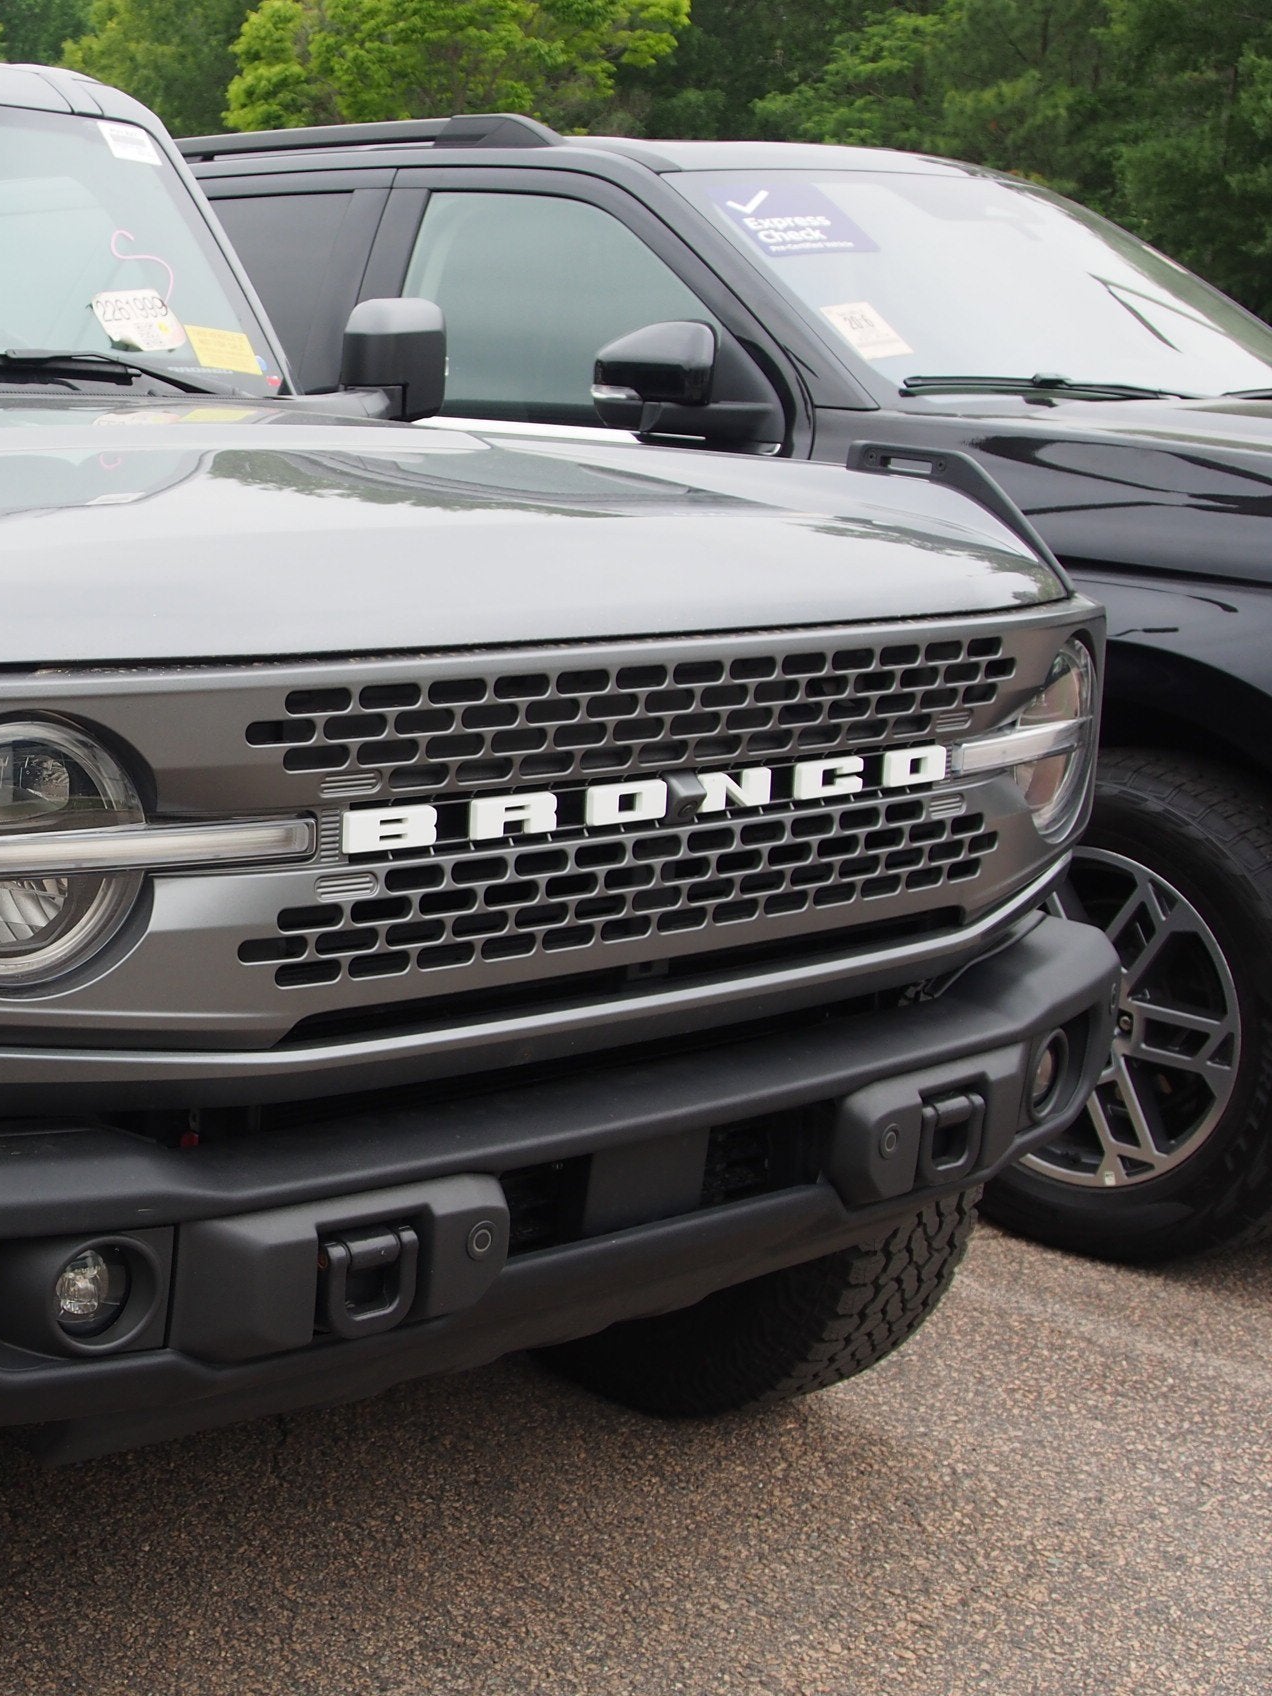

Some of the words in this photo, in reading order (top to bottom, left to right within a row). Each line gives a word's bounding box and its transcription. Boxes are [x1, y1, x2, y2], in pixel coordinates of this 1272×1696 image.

[742, 216, 832, 230] Express
[757, 227, 828, 243] Check
[96, 297, 168, 322] 2261999
[341, 744, 947, 855] BRONCO
